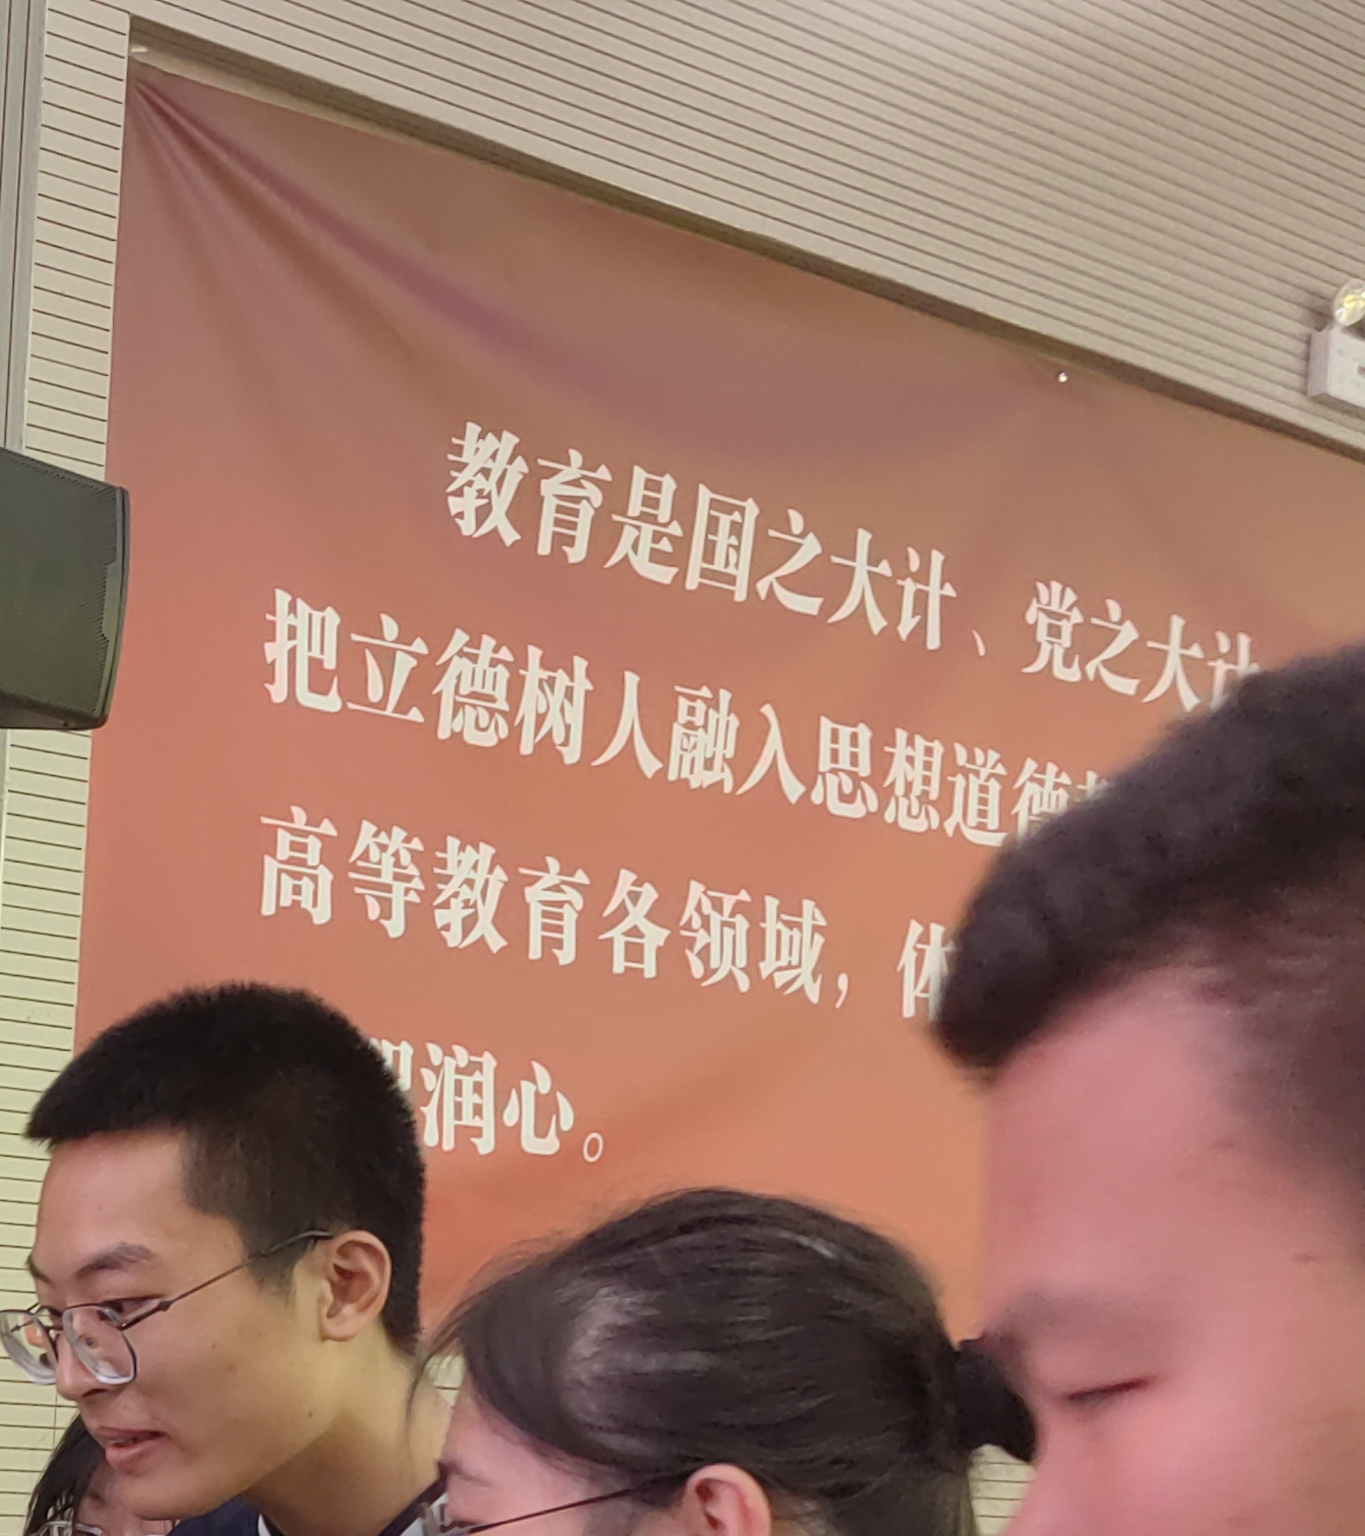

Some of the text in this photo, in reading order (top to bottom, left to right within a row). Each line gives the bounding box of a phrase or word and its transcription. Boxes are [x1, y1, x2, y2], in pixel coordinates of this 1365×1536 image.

[263, 588, 1111, 848] 把立德树人融入思想道德
[369, 1037, 604, 1163] 润心。
